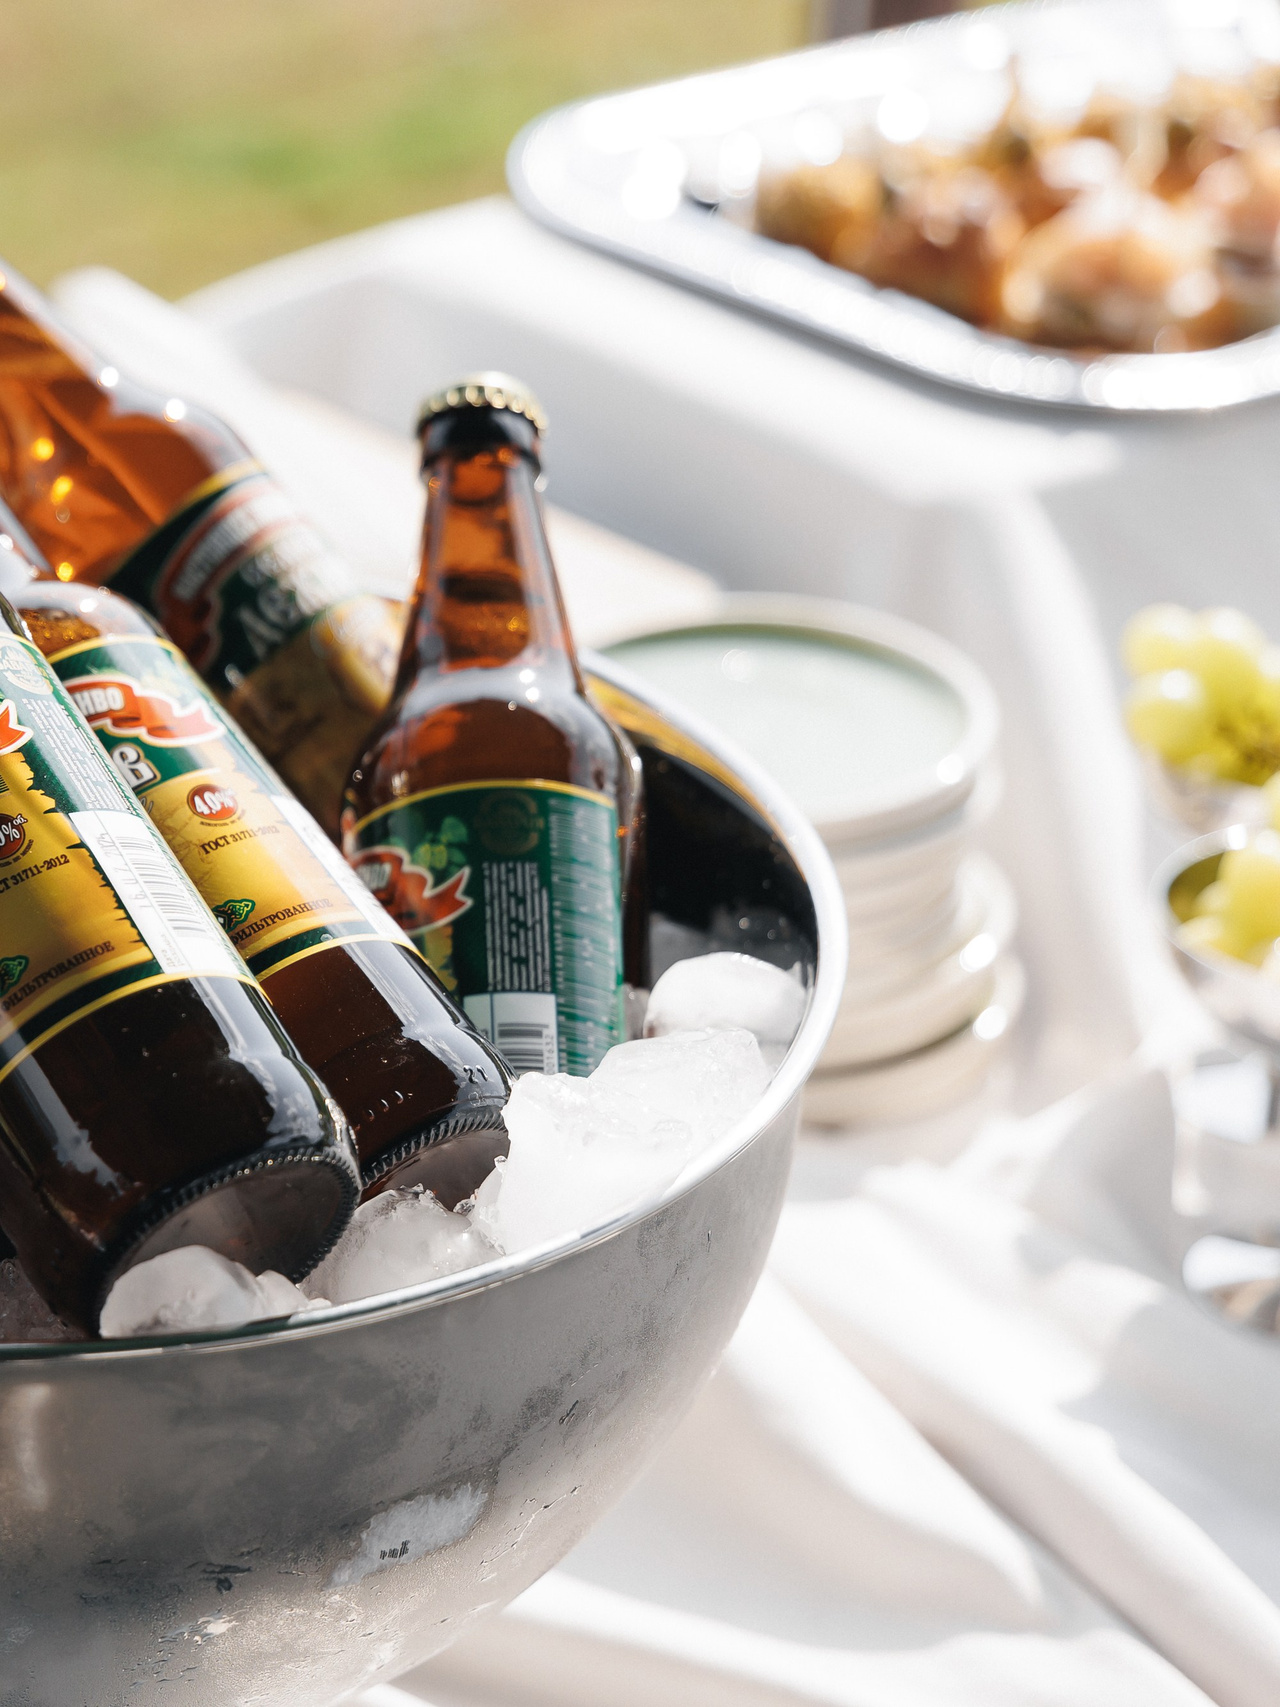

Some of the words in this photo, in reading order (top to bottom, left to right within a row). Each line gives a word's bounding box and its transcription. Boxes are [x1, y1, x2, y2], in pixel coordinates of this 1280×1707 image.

[71, 687, 124, 717] ИВО
[200, 837, 229, 856] ГОСТ
[232, 825, 279, 843] 31711-2012
[10, 854, 70, 886] 31711-2012
[1, 941, 115, 1011] ФИЛЬТРОВАННОЕ
